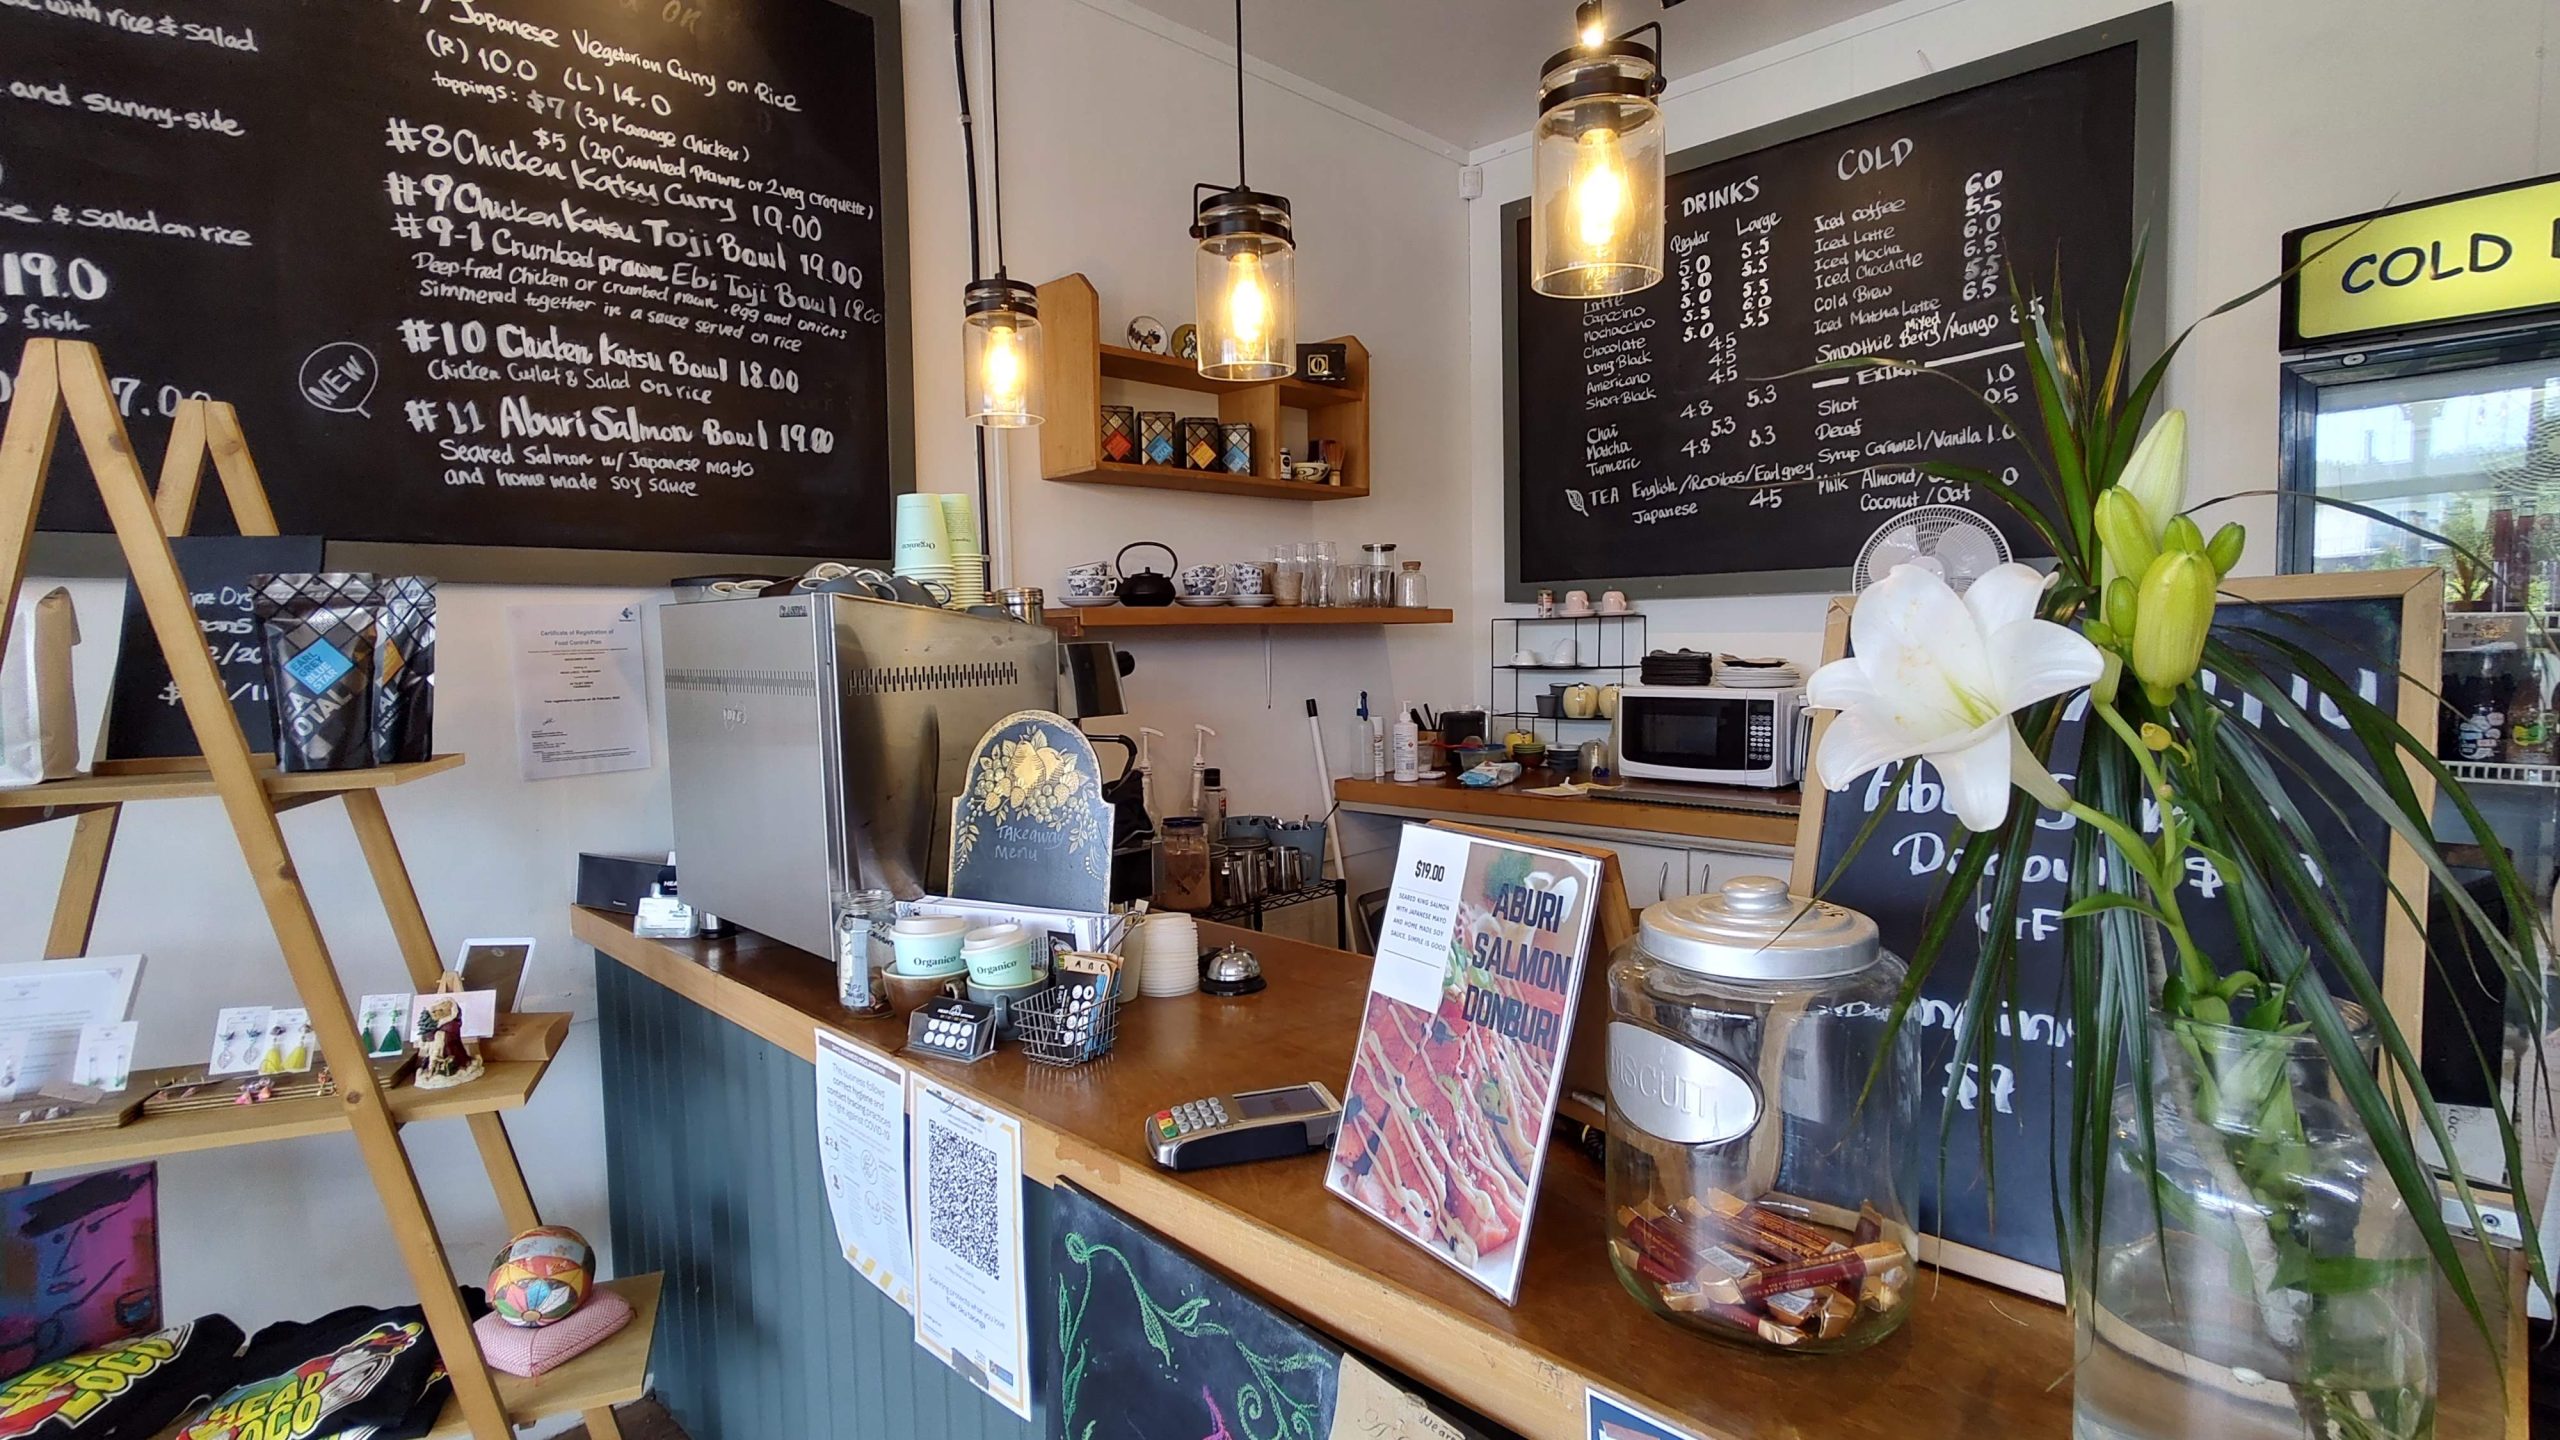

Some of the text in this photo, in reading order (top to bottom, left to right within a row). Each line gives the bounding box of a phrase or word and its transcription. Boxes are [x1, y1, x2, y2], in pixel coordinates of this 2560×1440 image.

[106, 9, 179, 37] rice &
[450, 0, 802, 112] Japanese Vegetarian Curry on Rice
[10, 81, 71, 106] and
[526, 89, 565, 120] $7
[532, 127, 762, 193] $5 or
[1681, 137, 1914, 218] DRINKS COLD
[663, 183, 737, 223] Curry
[1814, 212, 1846, 234] Iced
[1965, 170, 2003, 196] 6.0
[52, 204, 71, 225] &
[162, 223, 195, 238] on
[200, 226, 252, 246] rice
[453, 182, 787, 272] Chicken Katsu Toji Bowl
[1670, 211, 1783, 257] Regular Large
[1814, 191, 2002, 254] Iced Latte 5.5
[1678, 237, 1769, 277] 5.0 5.5
[1814, 213, 2002, 272] Iced Mocha 6.0
[3, 252, 108, 300] 19.0
[492, 228, 837, 317] Crumbed Ebi Toji Bowl
[1681, 256, 1768, 291] 5.0 5.5
[1815, 231, 2001, 290] Iced 6.5
[2342, 232, 2513, 294] COLD
[508, 266, 792, 328] Chicken or crumbed and
[1680, 278, 1769, 309] 5.0 5.5
[1814, 285, 1893, 313] Cold Brew
[1814, 275, 1999, 336] Iced Matcha Latte 6.5
[22, 304, 91, 330] fish
[419, 279, 802, 353] Simmered together a sauce served on rice
[1584, 306, 1770, 343] Mochaccino 5.0 5.5
[1682, 306, 1710, 322] 5.5
[396, 318, 486, 356] #10
[496, 323, 593, 365] Chicken
[599, 332, 664, 372] Katsu
[669, 350, 728, 382] Bowl
[1583, 331, 1737, 359] Chocolate 4.5
[1587, 349, 1737, 377] Long Black 4.5
[1587, 364, 1738, 395] Americano 4.5
[308, 354, 367, 406] NEW
[427, 359, 501, 381] Chicken
[566, 370, 578, 388] &
[583, 367, 631, 390] Salad
[640, 379, 672, 397] on
[676, 386, 712, 404] rice
[1620, 387, 1657, 404] Black
[1746, 384, 1778, 408] 5.3
[1817, 364, 2016, 417] Shot 1.0
[500, 395, 768, 451] Aburi Salmon Bowl
[1587, 415, 1736, 445] Chai 5.3
[1815, 418, 1862, 440] Decaf
[439, 438, 700, 474] Seared Salmon w/ Japanese
[1586, 441, 1633, 461] Matcha
[1586, 457, 1642, 477] Turmeric
[1817, 448, 1861, 464] Syrup
[444, 468, 699, 498] and home made soy sauce
[1588, 486, 1619, 507] TEA
[1632, 503, 1699, 525] Japanese
[1860, 491, 1920, 512] Coconut
[290, 652, 317, 671] EARL
[299, 656, 324, 677] GREY
[305, 663, 332, 684] BLUE
[313, 669, 338, 690] STAR
[1414, 860, 1445, 883] $19.00
[1409, 909, 1431, 920] JAPANESE
[1430, 901, 1449, 910] SALMON
[1492, 882, 1565, 934] ABURI
[913, 955, 958, 968] Organico
[976, 960, 1018, 975] Organico
[1471, 932, 1573, 996] SALMON
[1461, 984, 1561, 1051] DONBURI
